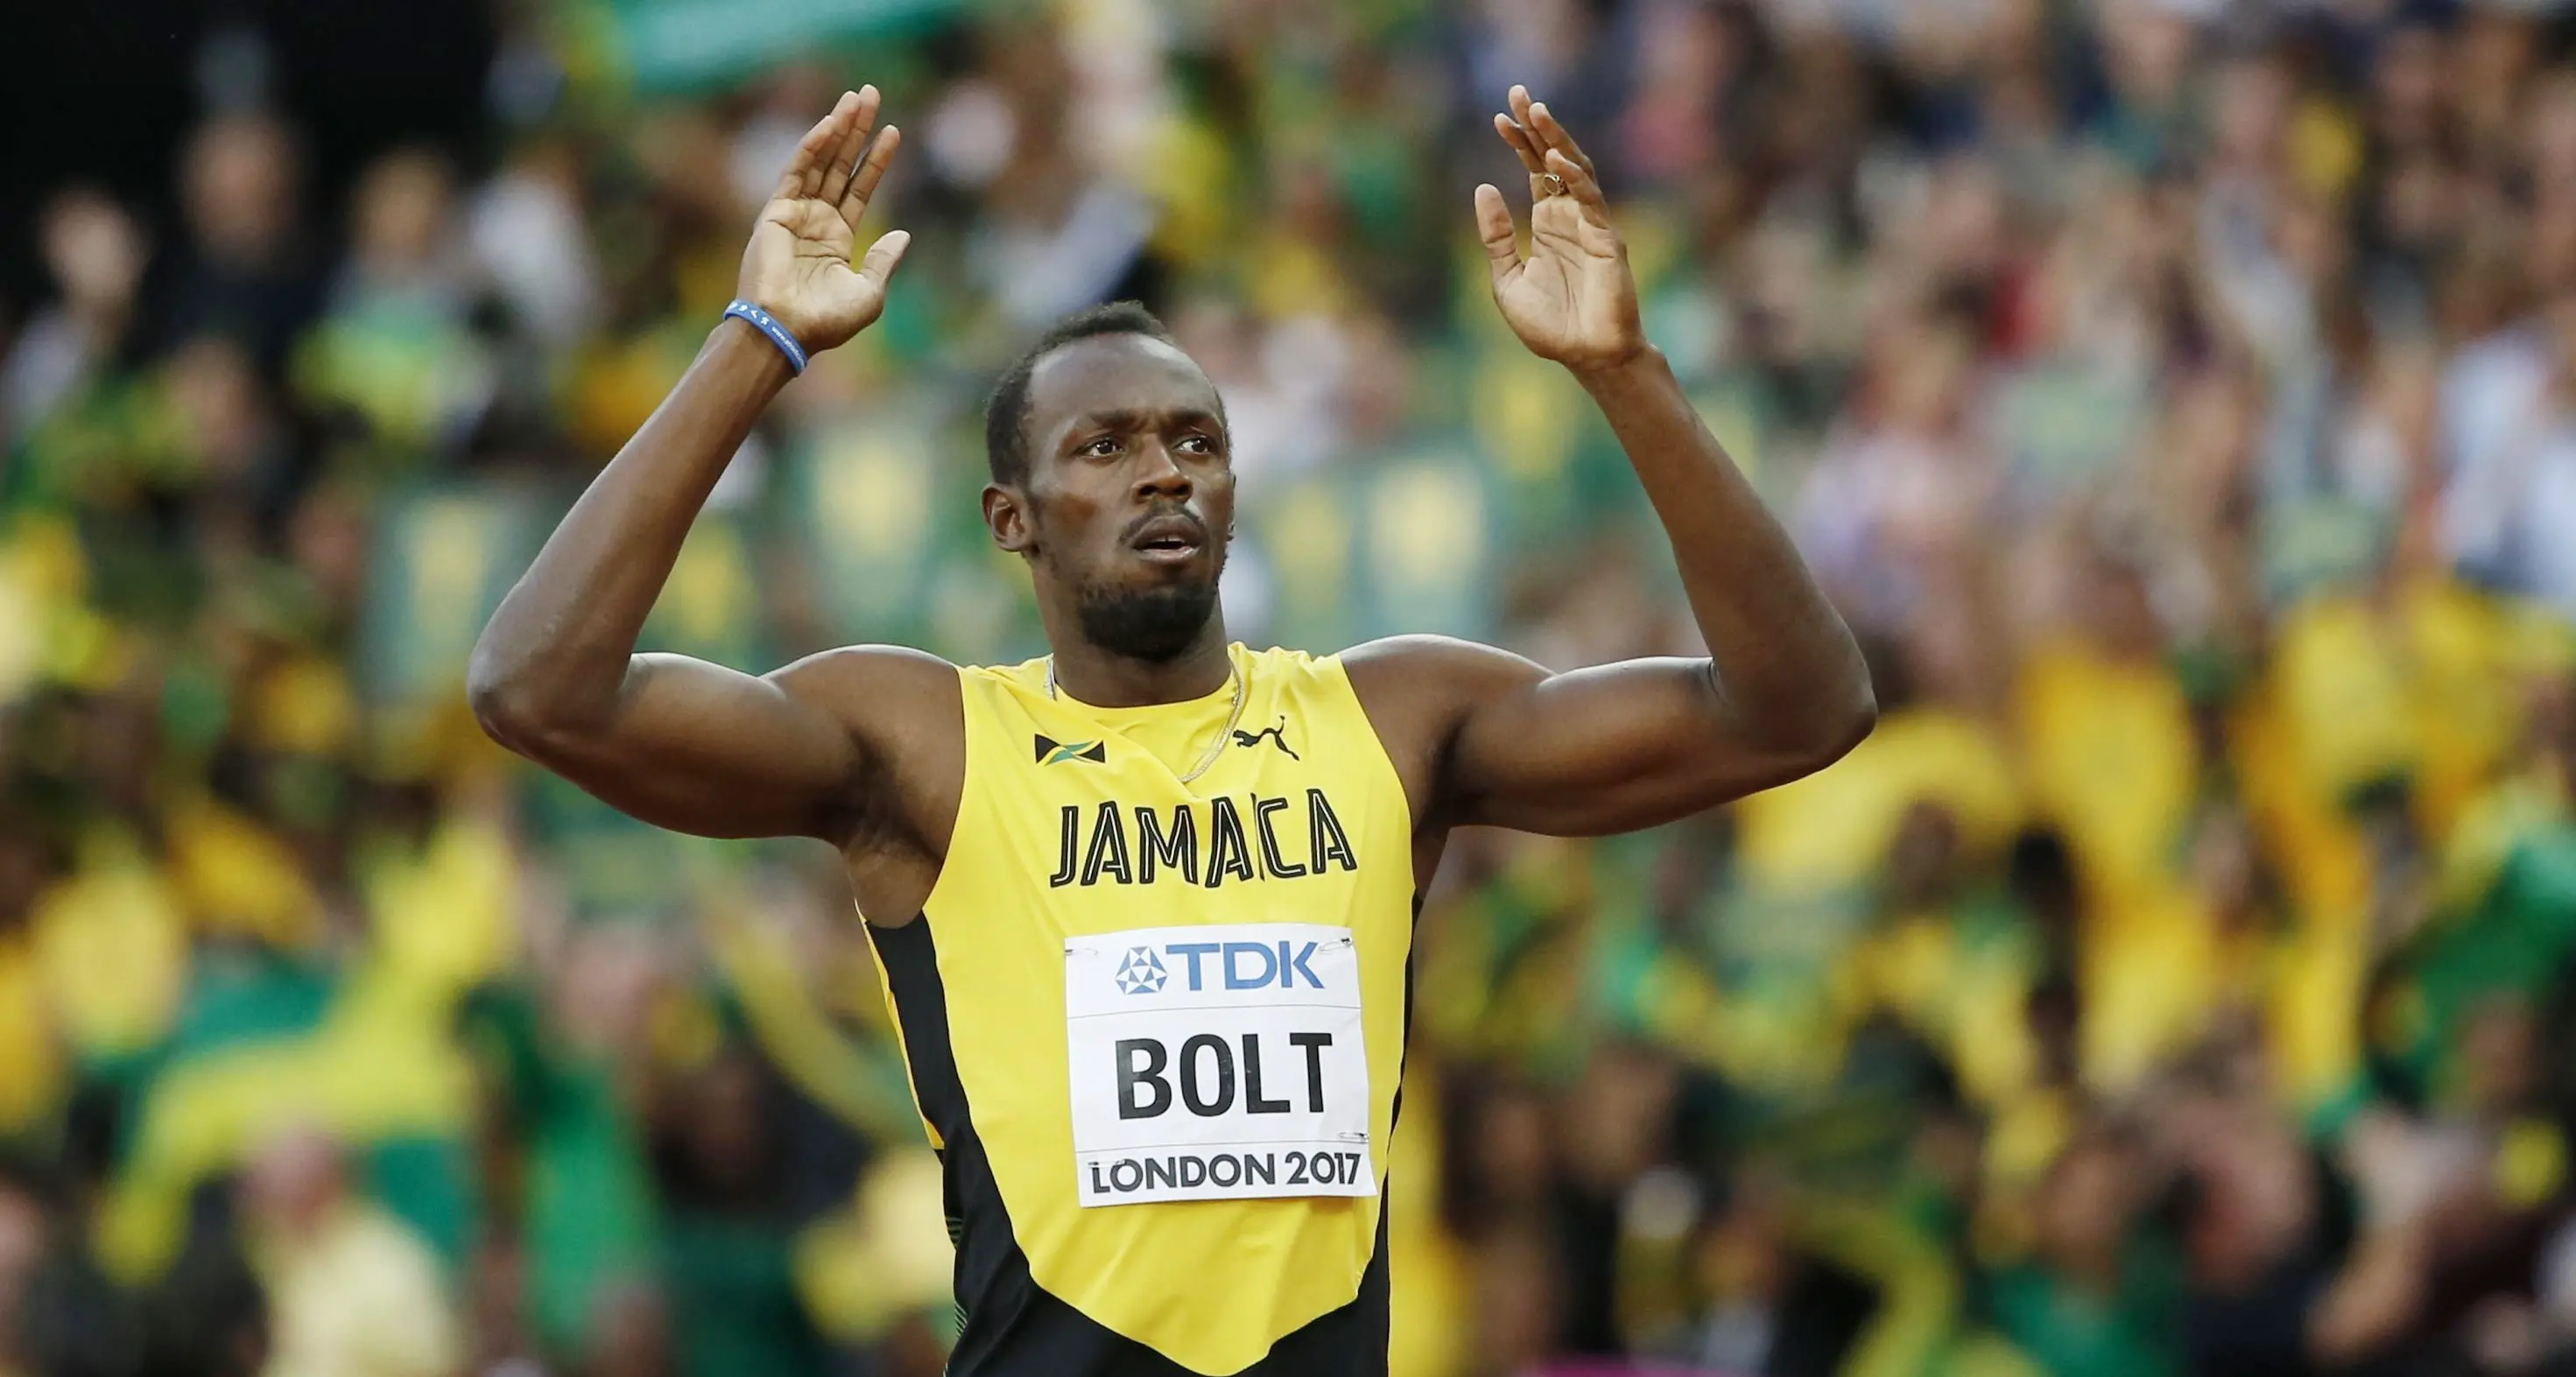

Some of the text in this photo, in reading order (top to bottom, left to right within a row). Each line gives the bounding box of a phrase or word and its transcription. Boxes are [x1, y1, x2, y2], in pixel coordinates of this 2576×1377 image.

[1165, 941, 1325, 992] TDK
[1115, 1032, 1333, 1121] BOLT
[1091, 1151, 1362, 1194] LONDON 2017
